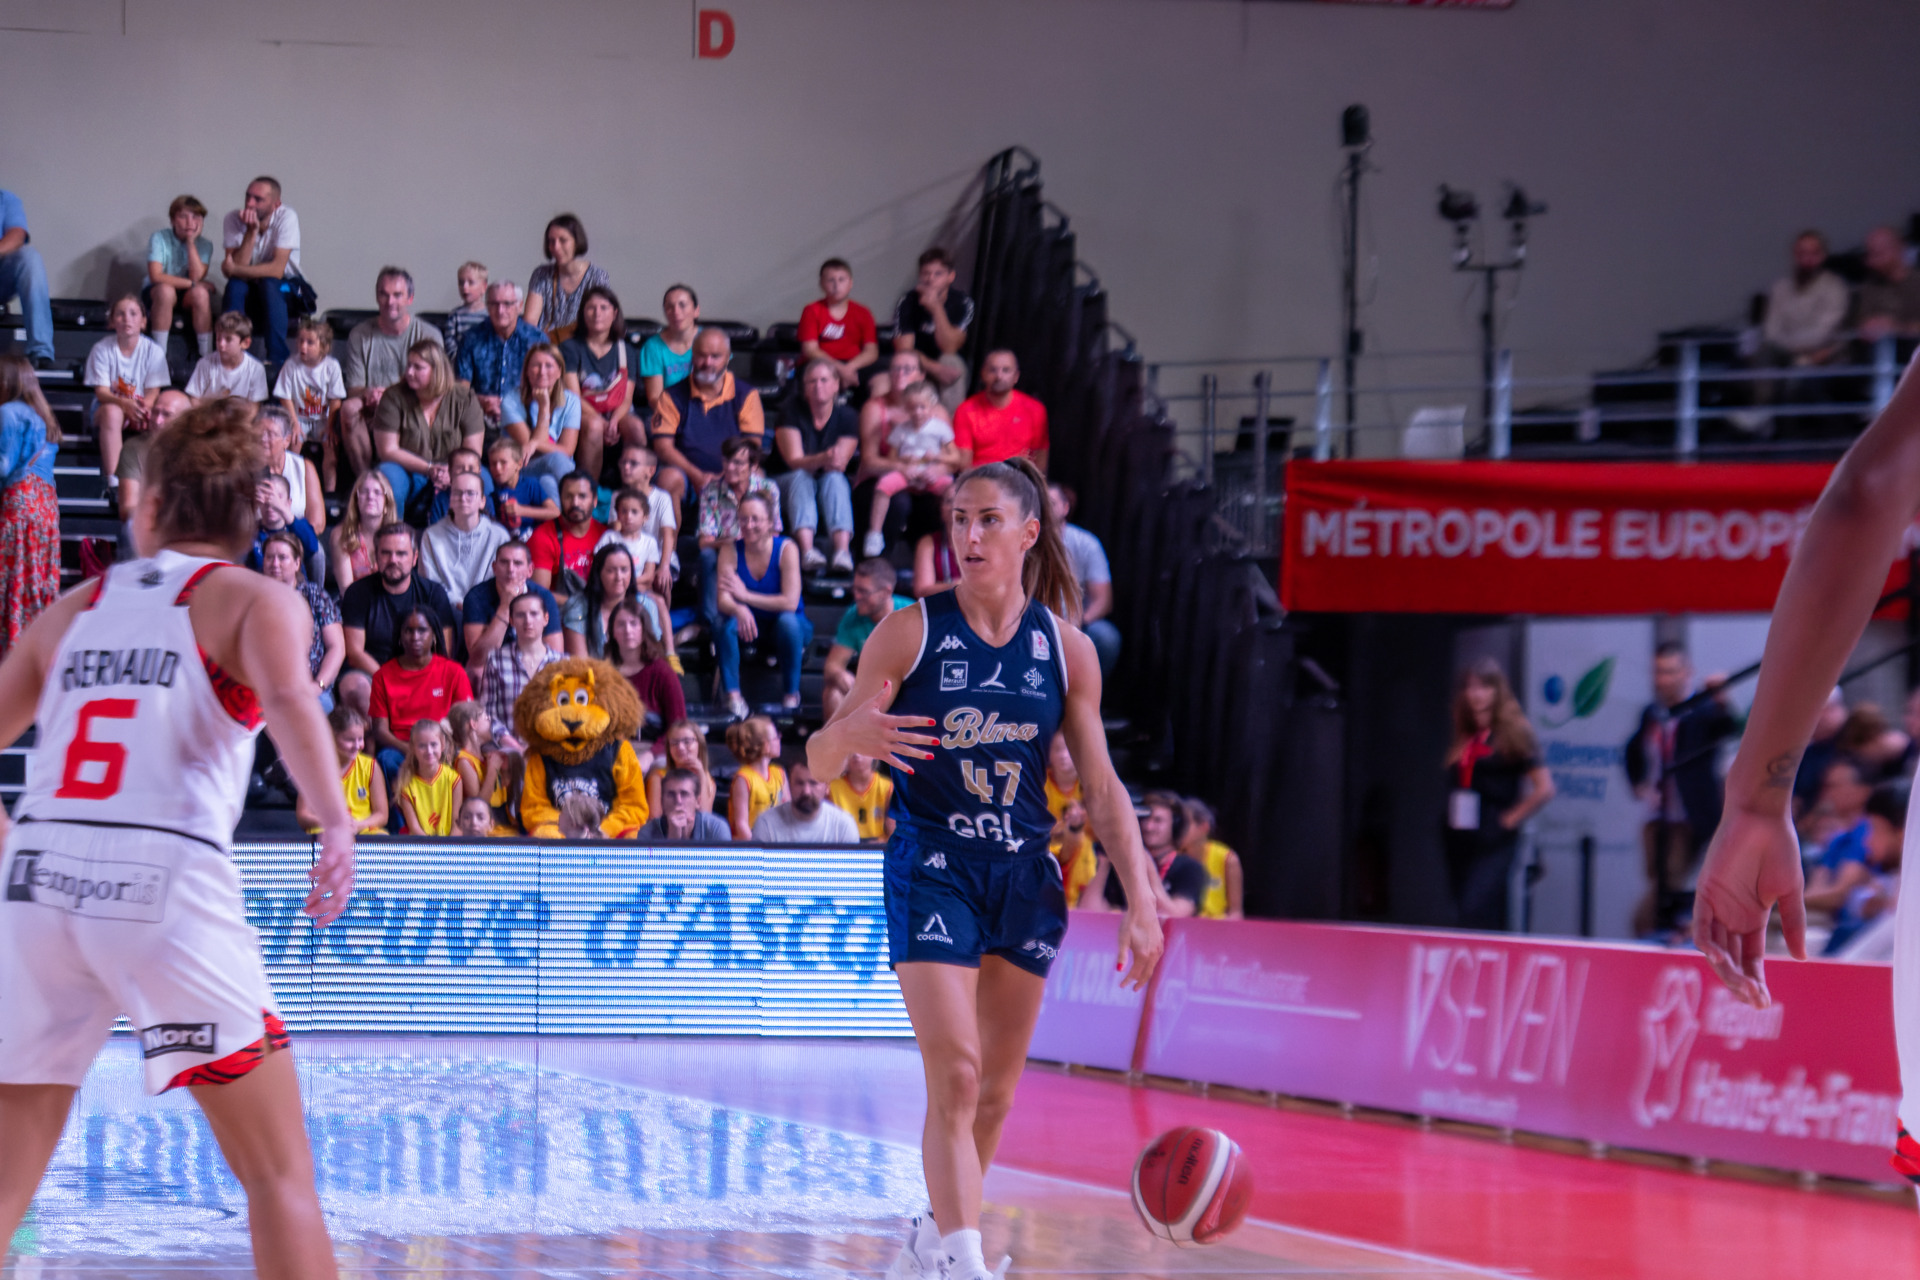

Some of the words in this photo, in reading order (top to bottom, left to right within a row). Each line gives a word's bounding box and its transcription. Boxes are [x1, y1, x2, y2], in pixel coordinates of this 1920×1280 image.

[698, 9, 736, 59] D
[1303, 496, 1602, 559] MÉTROPOLE
[54, 698, 141, 801] 6
[941, 706, 1039, 750] Blma
[961, 760, 1022, 806] 47
[916, 933, 953, 945] COGEDIM
[144, 1024, 212, 1051] Nord
